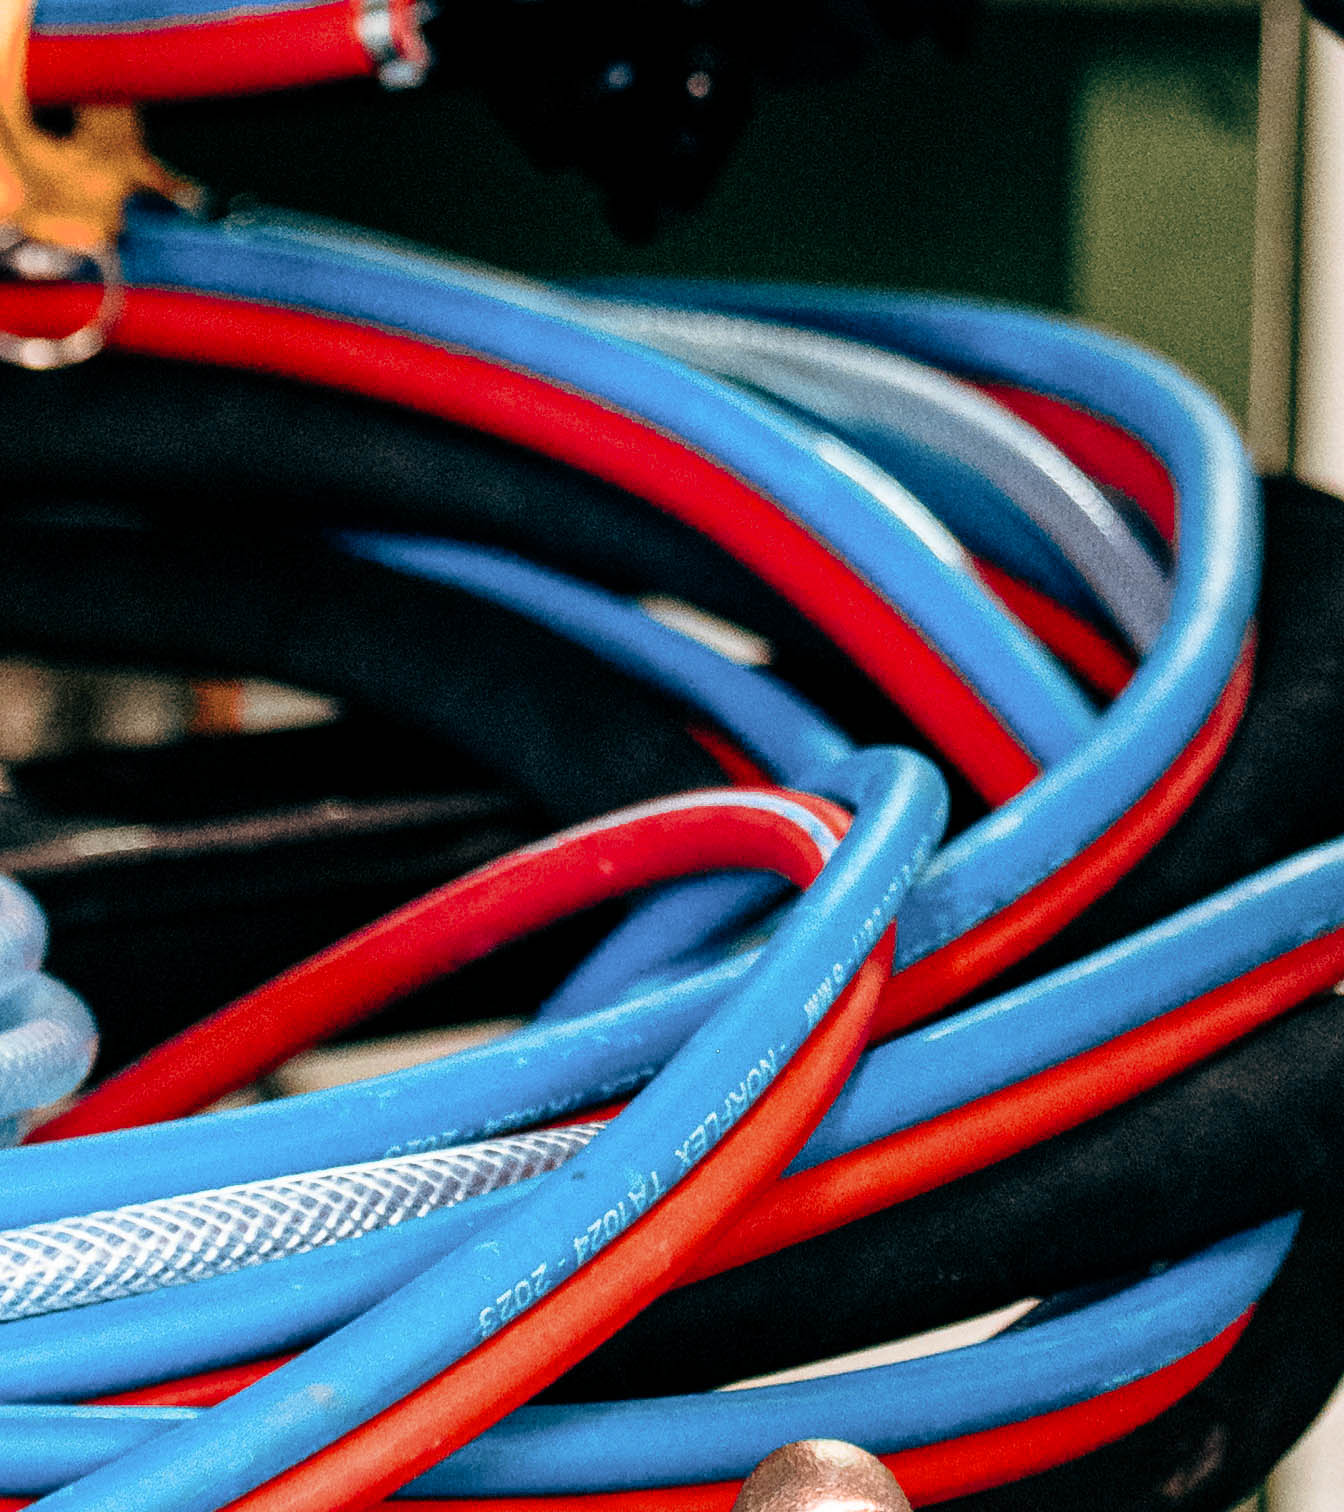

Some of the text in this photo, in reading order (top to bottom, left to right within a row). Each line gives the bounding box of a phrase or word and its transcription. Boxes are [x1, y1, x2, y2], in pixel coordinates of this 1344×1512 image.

[673, 1048, 778, 1167] NORFLEX
[572, 1170, 663, 1253] TA1024
[479, 1262, 550, 1337] 2023
